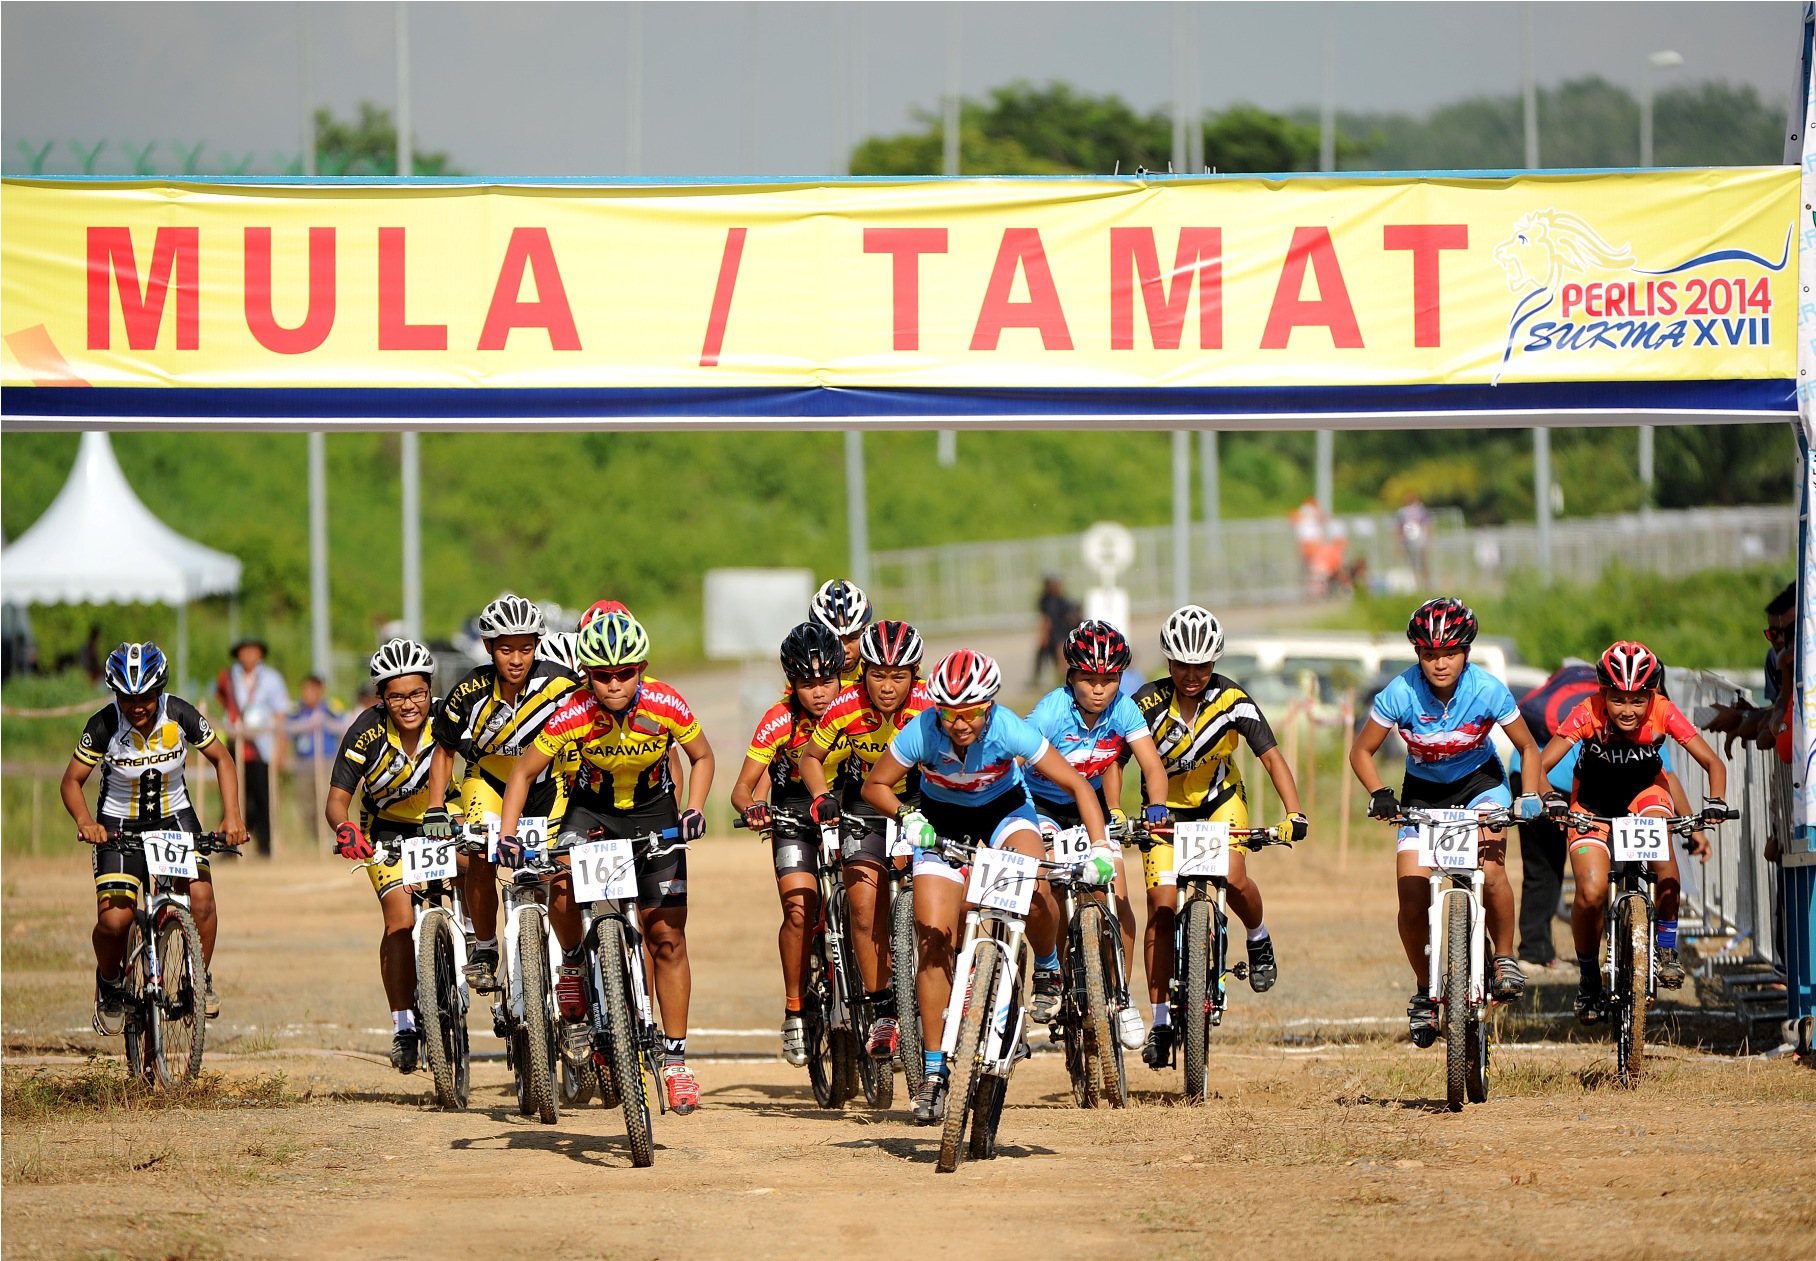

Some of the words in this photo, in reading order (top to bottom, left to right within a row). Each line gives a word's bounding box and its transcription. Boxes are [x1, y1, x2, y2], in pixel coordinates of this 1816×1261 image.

[86, 226, 583, 355] MULA
[699, 227, 747, 367] /
[863, 223, 1469, 351] TAMAT
[1562, 280, 1678, 318] PERLIS
[1684, 277, 1772, 316] 2014
[1523, 319, 1688, 352] SUKMA
[1693, 317, 1771, 347] XVII
[548, 695, 598, 729] SARAWAK
[641, 688, 692, 720] SARAWAK
[586, 740, 661, 758] SARAWAK
[517, 818, 534, 827] NB
[1443, 811, 1466, 821] TNB
[1633, 818, 1655, 827] TNB
[1195, 823, 1216, 833] TNB
[161, 832, 183, 841] TNB
[1426, 825, 1471, 852] 162
[1619, 829, 1662, 849] 155
[149, 843, 189, 865] 167
[593, 842, 618, 853] TNB
[1061, 836, 1088, 856] 16
[1179, 836, 1223, 861] 159
[407, 847, 450, 871] 158
[1001, 852, 1025, 866] TNB
[1442, 855, 1466, 866] TNB
[1636, 851, 1659, 860] TNB
[168, 866, 189, 876] TNB
[424, 869, 446, 879] TNB
[578, 855, 628, 887] 165
[1195, 864, 1217, 874] TNB
[980, 862, 1025, 897] 161
[601, 886, 624, 897] TNB
[993, 896, 1017, 909] TNB
